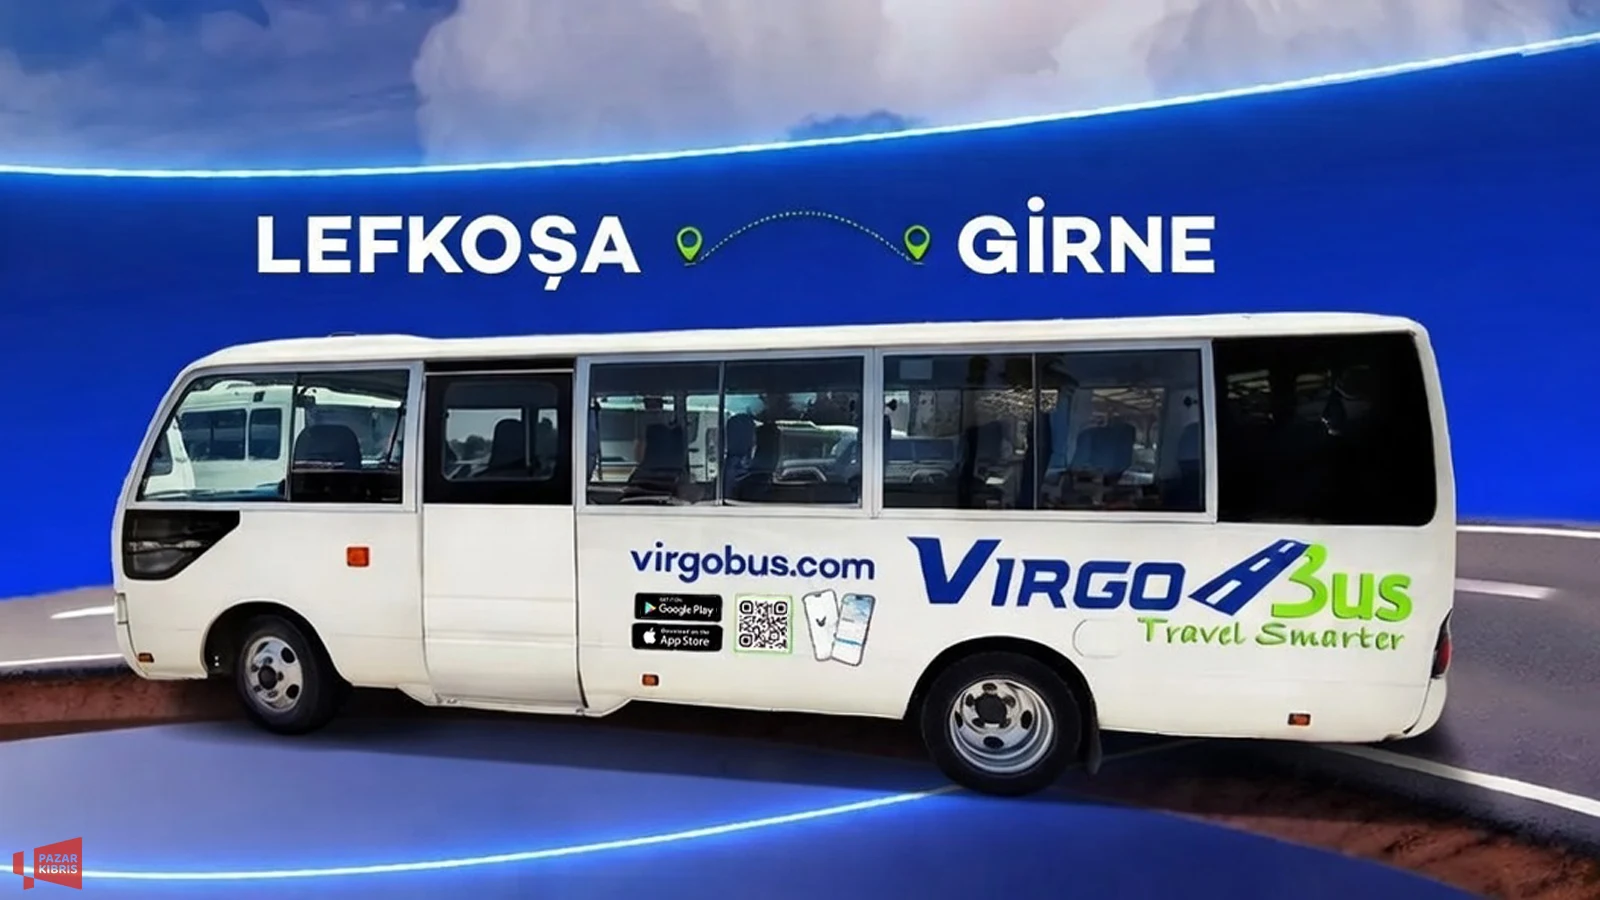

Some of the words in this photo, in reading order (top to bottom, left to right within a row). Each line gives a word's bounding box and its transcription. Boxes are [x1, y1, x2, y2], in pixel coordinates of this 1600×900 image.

[631, 541, 875, 583] virgobus.com
[658, 603, 692, 617] Google
[693, 604, 714, 618] Play
[660, 635, 681, 647] App
[682, 635, 710, 647] Store
[1137, 617, 1246, 646] Travel
[1255, 622, 1404, 650] Smarter
